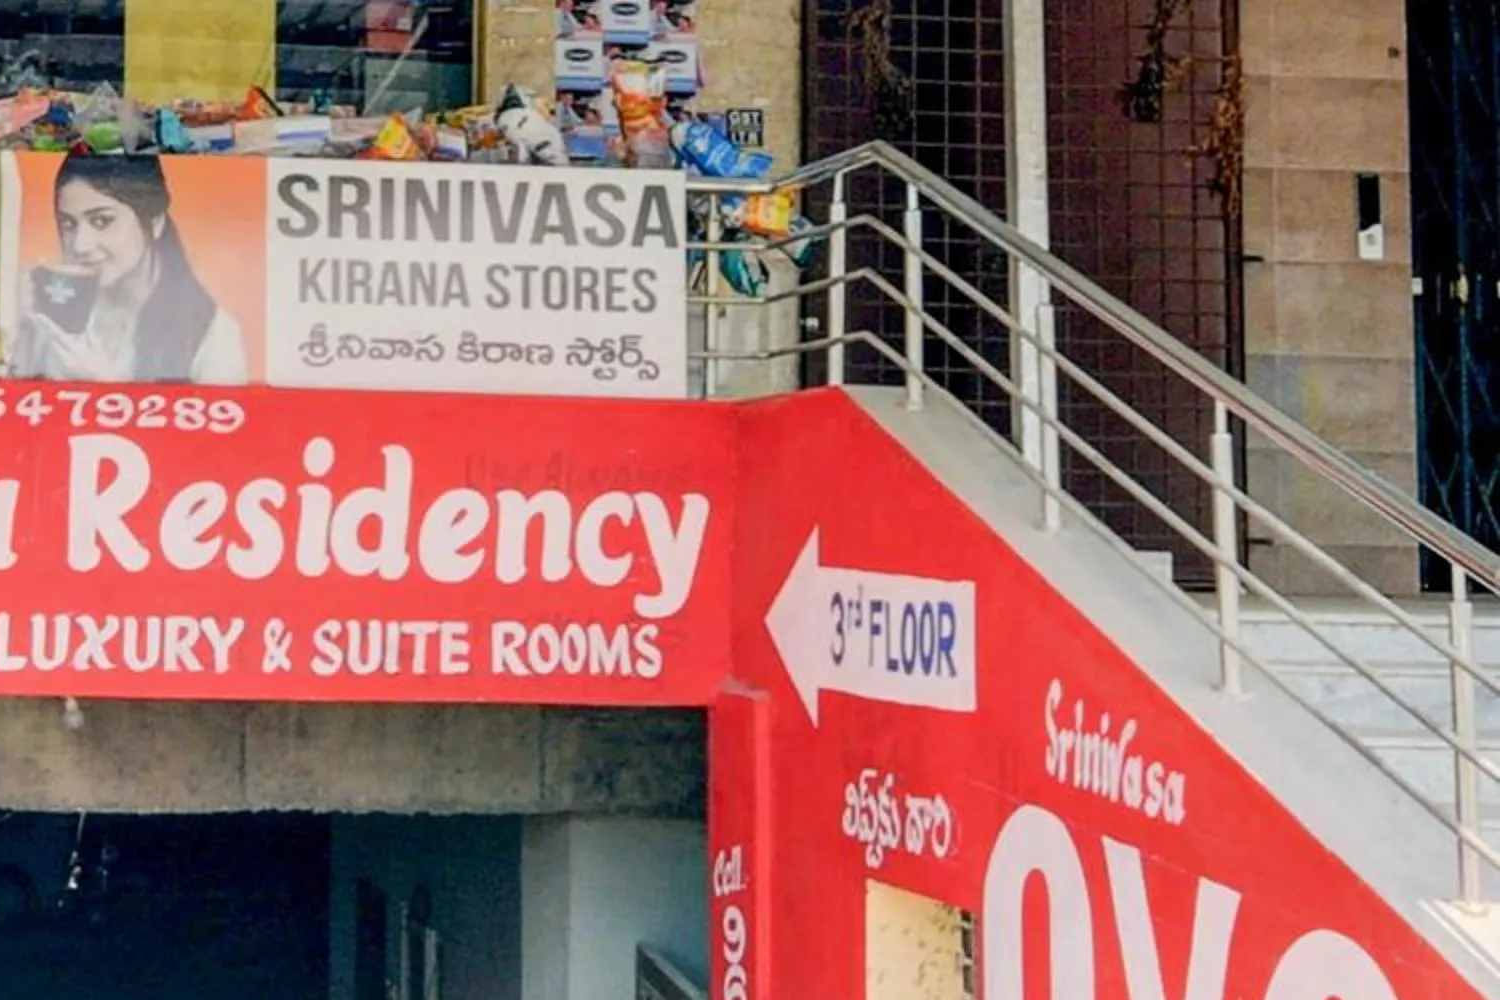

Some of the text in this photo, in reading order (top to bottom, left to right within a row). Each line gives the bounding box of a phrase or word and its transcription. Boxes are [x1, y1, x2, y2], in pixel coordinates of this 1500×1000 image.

[277, 173, 680, 249] SRINIVASA
[299, 257, 658, 314] KIRANA STORES
[298, 323, 445, 368] శ్రీనివాస
[67, 431, 710, 619] Residency
[261, 618, 293, 673] &
[310, 619, 470, 678] SUITE
[490, 620, 664, 679] ROOMS
[829, 582, 958, 678] 3rd FLOOR
[1043, 677, 1187, 825] Srinivasa
